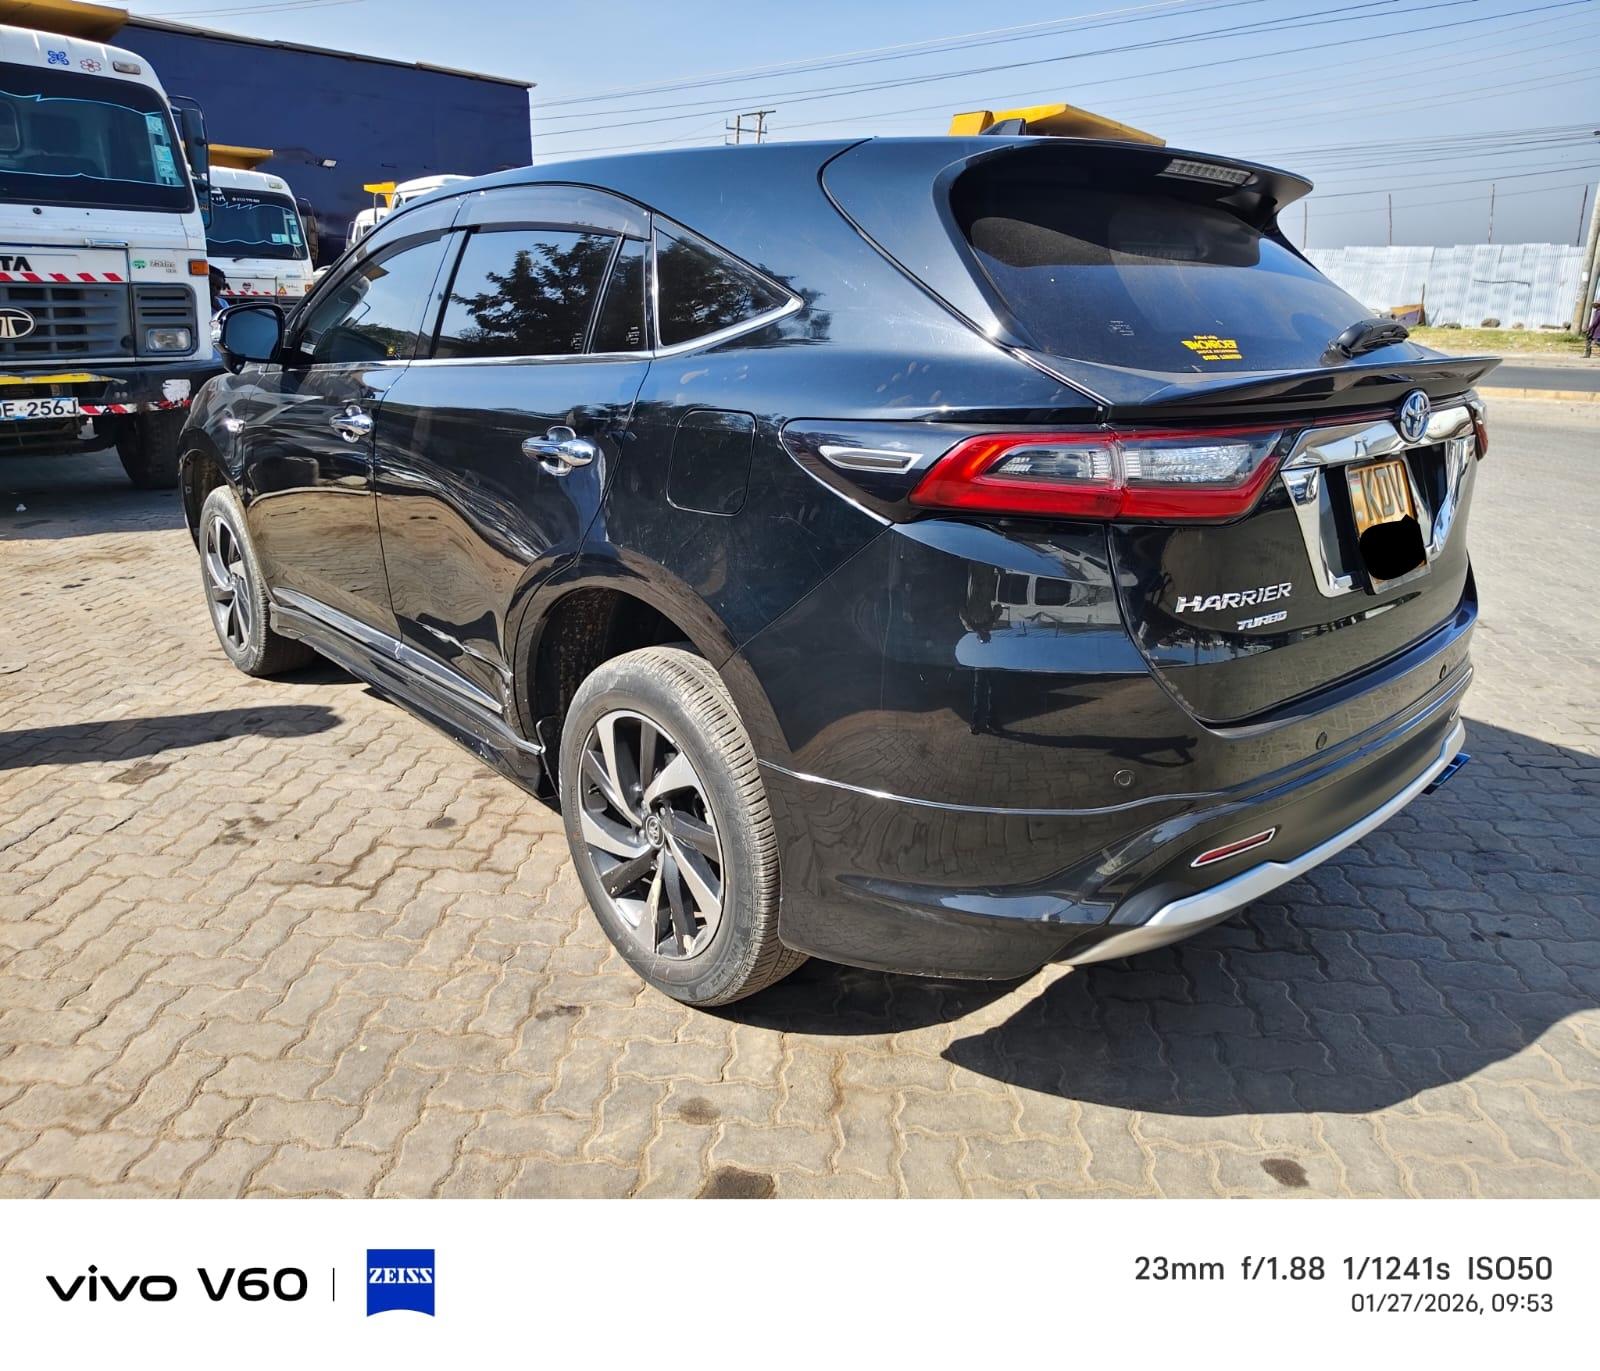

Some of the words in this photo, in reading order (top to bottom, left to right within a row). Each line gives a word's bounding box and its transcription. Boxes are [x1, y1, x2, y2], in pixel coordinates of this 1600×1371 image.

[27, 400, 77, 416] 256J
[1359, 463, 1405, 521] KDV
[1175, 582, 1292, 613] HARRIER
[1236, 610, 1288, 630] TURBO
